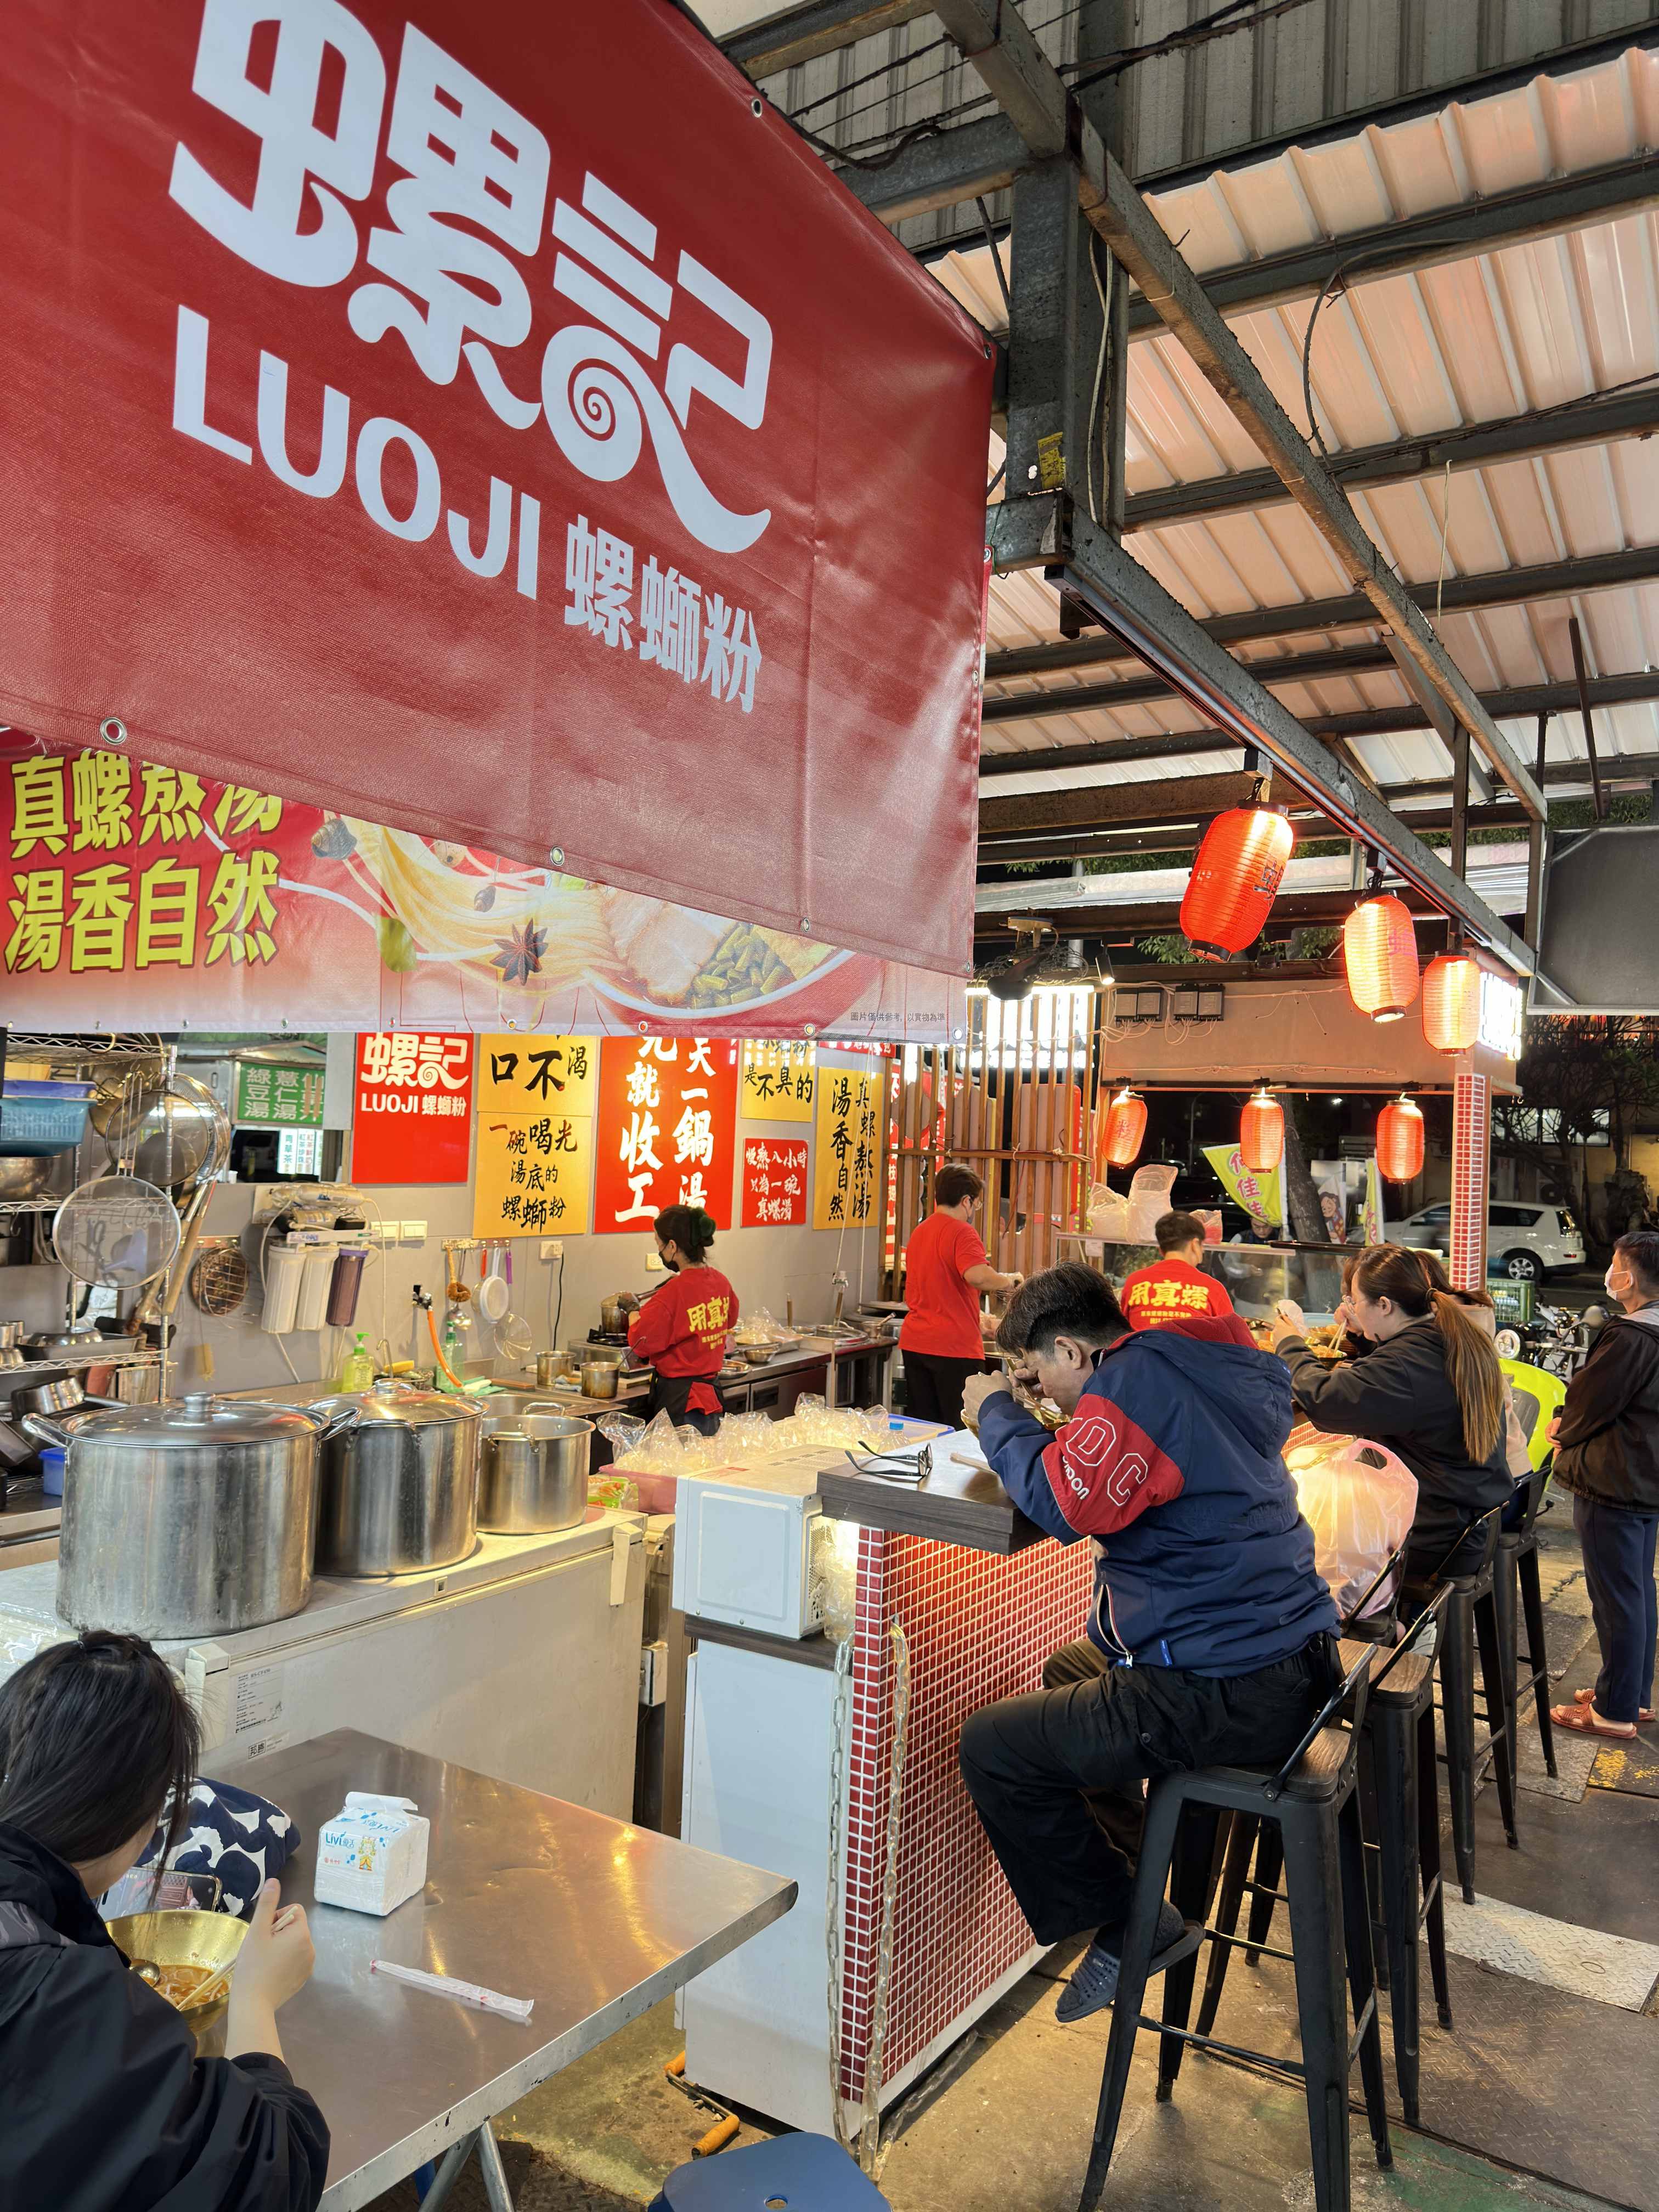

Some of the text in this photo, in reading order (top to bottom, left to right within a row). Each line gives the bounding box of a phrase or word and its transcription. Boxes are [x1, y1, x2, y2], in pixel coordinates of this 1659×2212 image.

[172, 304, 763, 713] LUOJI 螺螄粉
[5, 851, 279, 972] 湯香自然
[360, 1032, 469, 1089] 螺記
[244, 1067, 272, 1118] 綠豆湯
[361, 1094, 466, 1117] LUOJI 螺螄粉
[489, 1118, 578, 1155] 一碗喝光
[828, 1076, 854, 1221] 湯香自然
[511, 1161, 558, 1192] 湯底的
[501, 1196, 566, 1234] 螺螄粉
[1128, 1279, 1209, 1310] 用真螺
